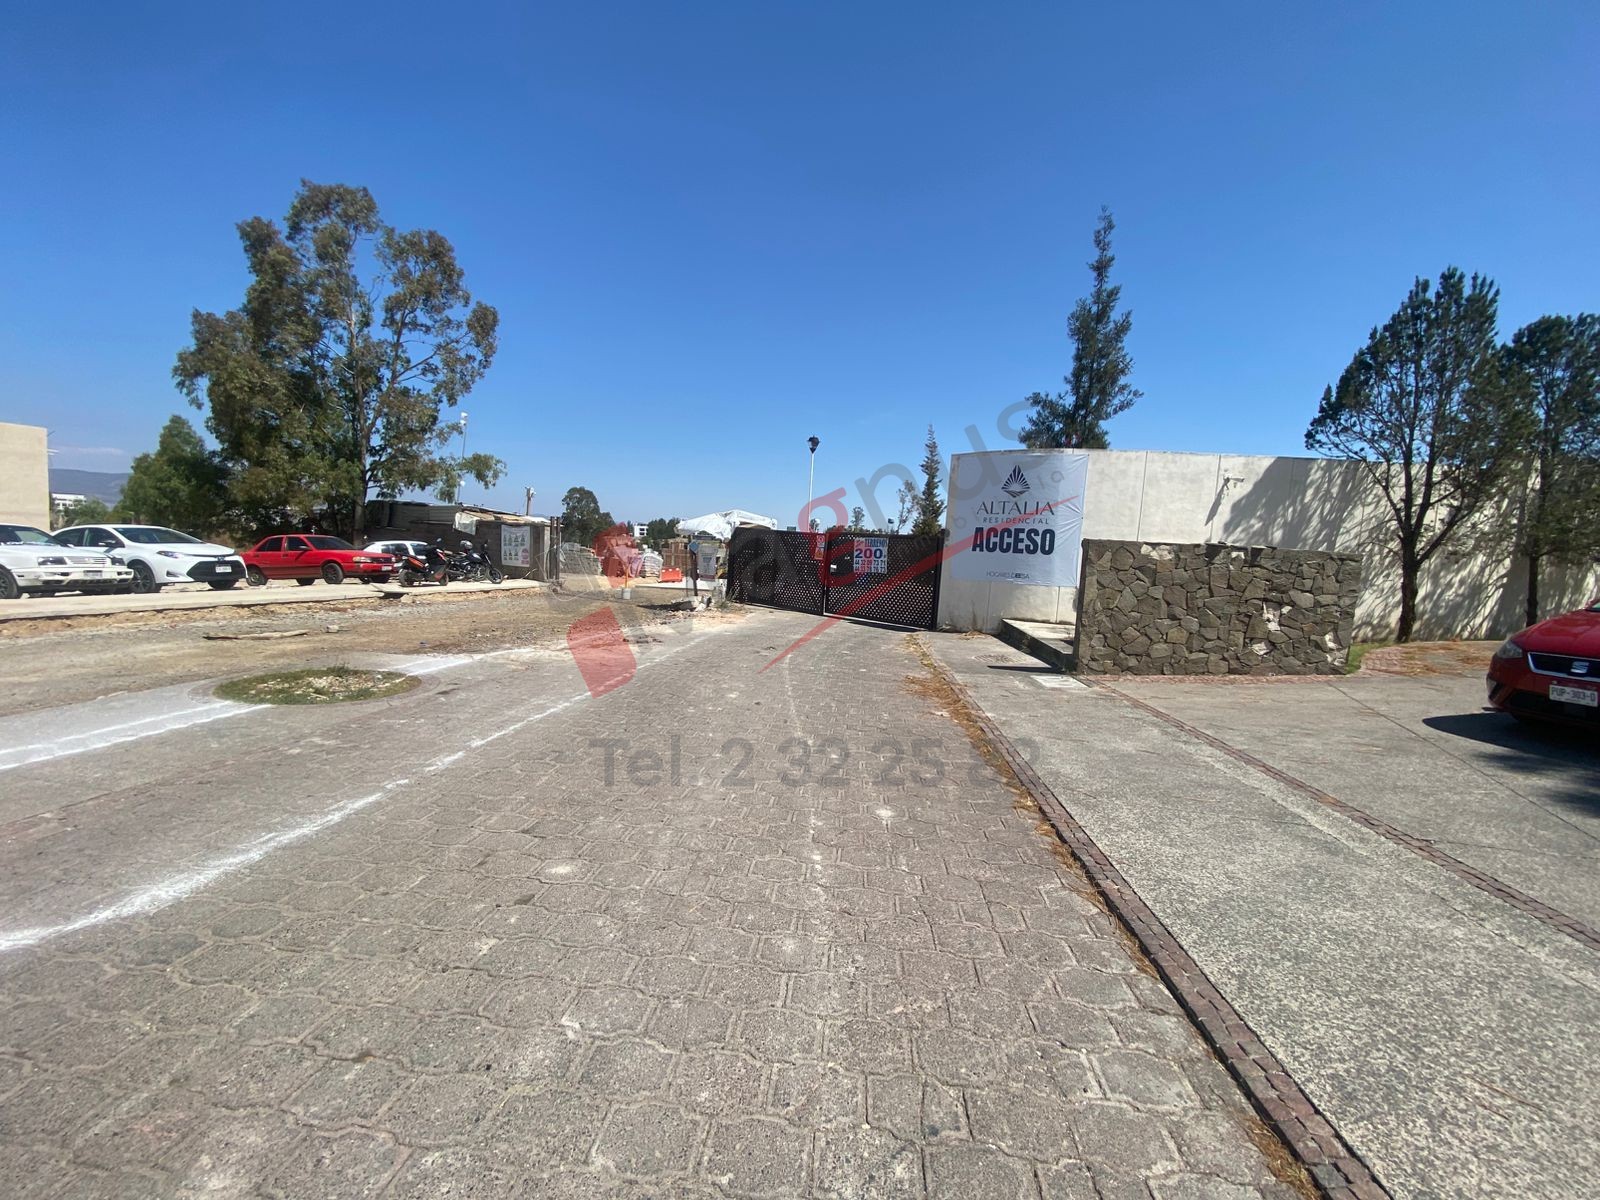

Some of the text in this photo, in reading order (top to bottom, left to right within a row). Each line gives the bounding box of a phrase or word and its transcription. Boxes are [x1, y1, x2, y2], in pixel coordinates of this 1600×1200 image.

[977, 501, 1055, 516] ALTALIA
[983, 517, 1049, 525] RESIDENCIAL
[972, 527, 1056, 556] ACCESO
[855, 548, 883, 559] 200
